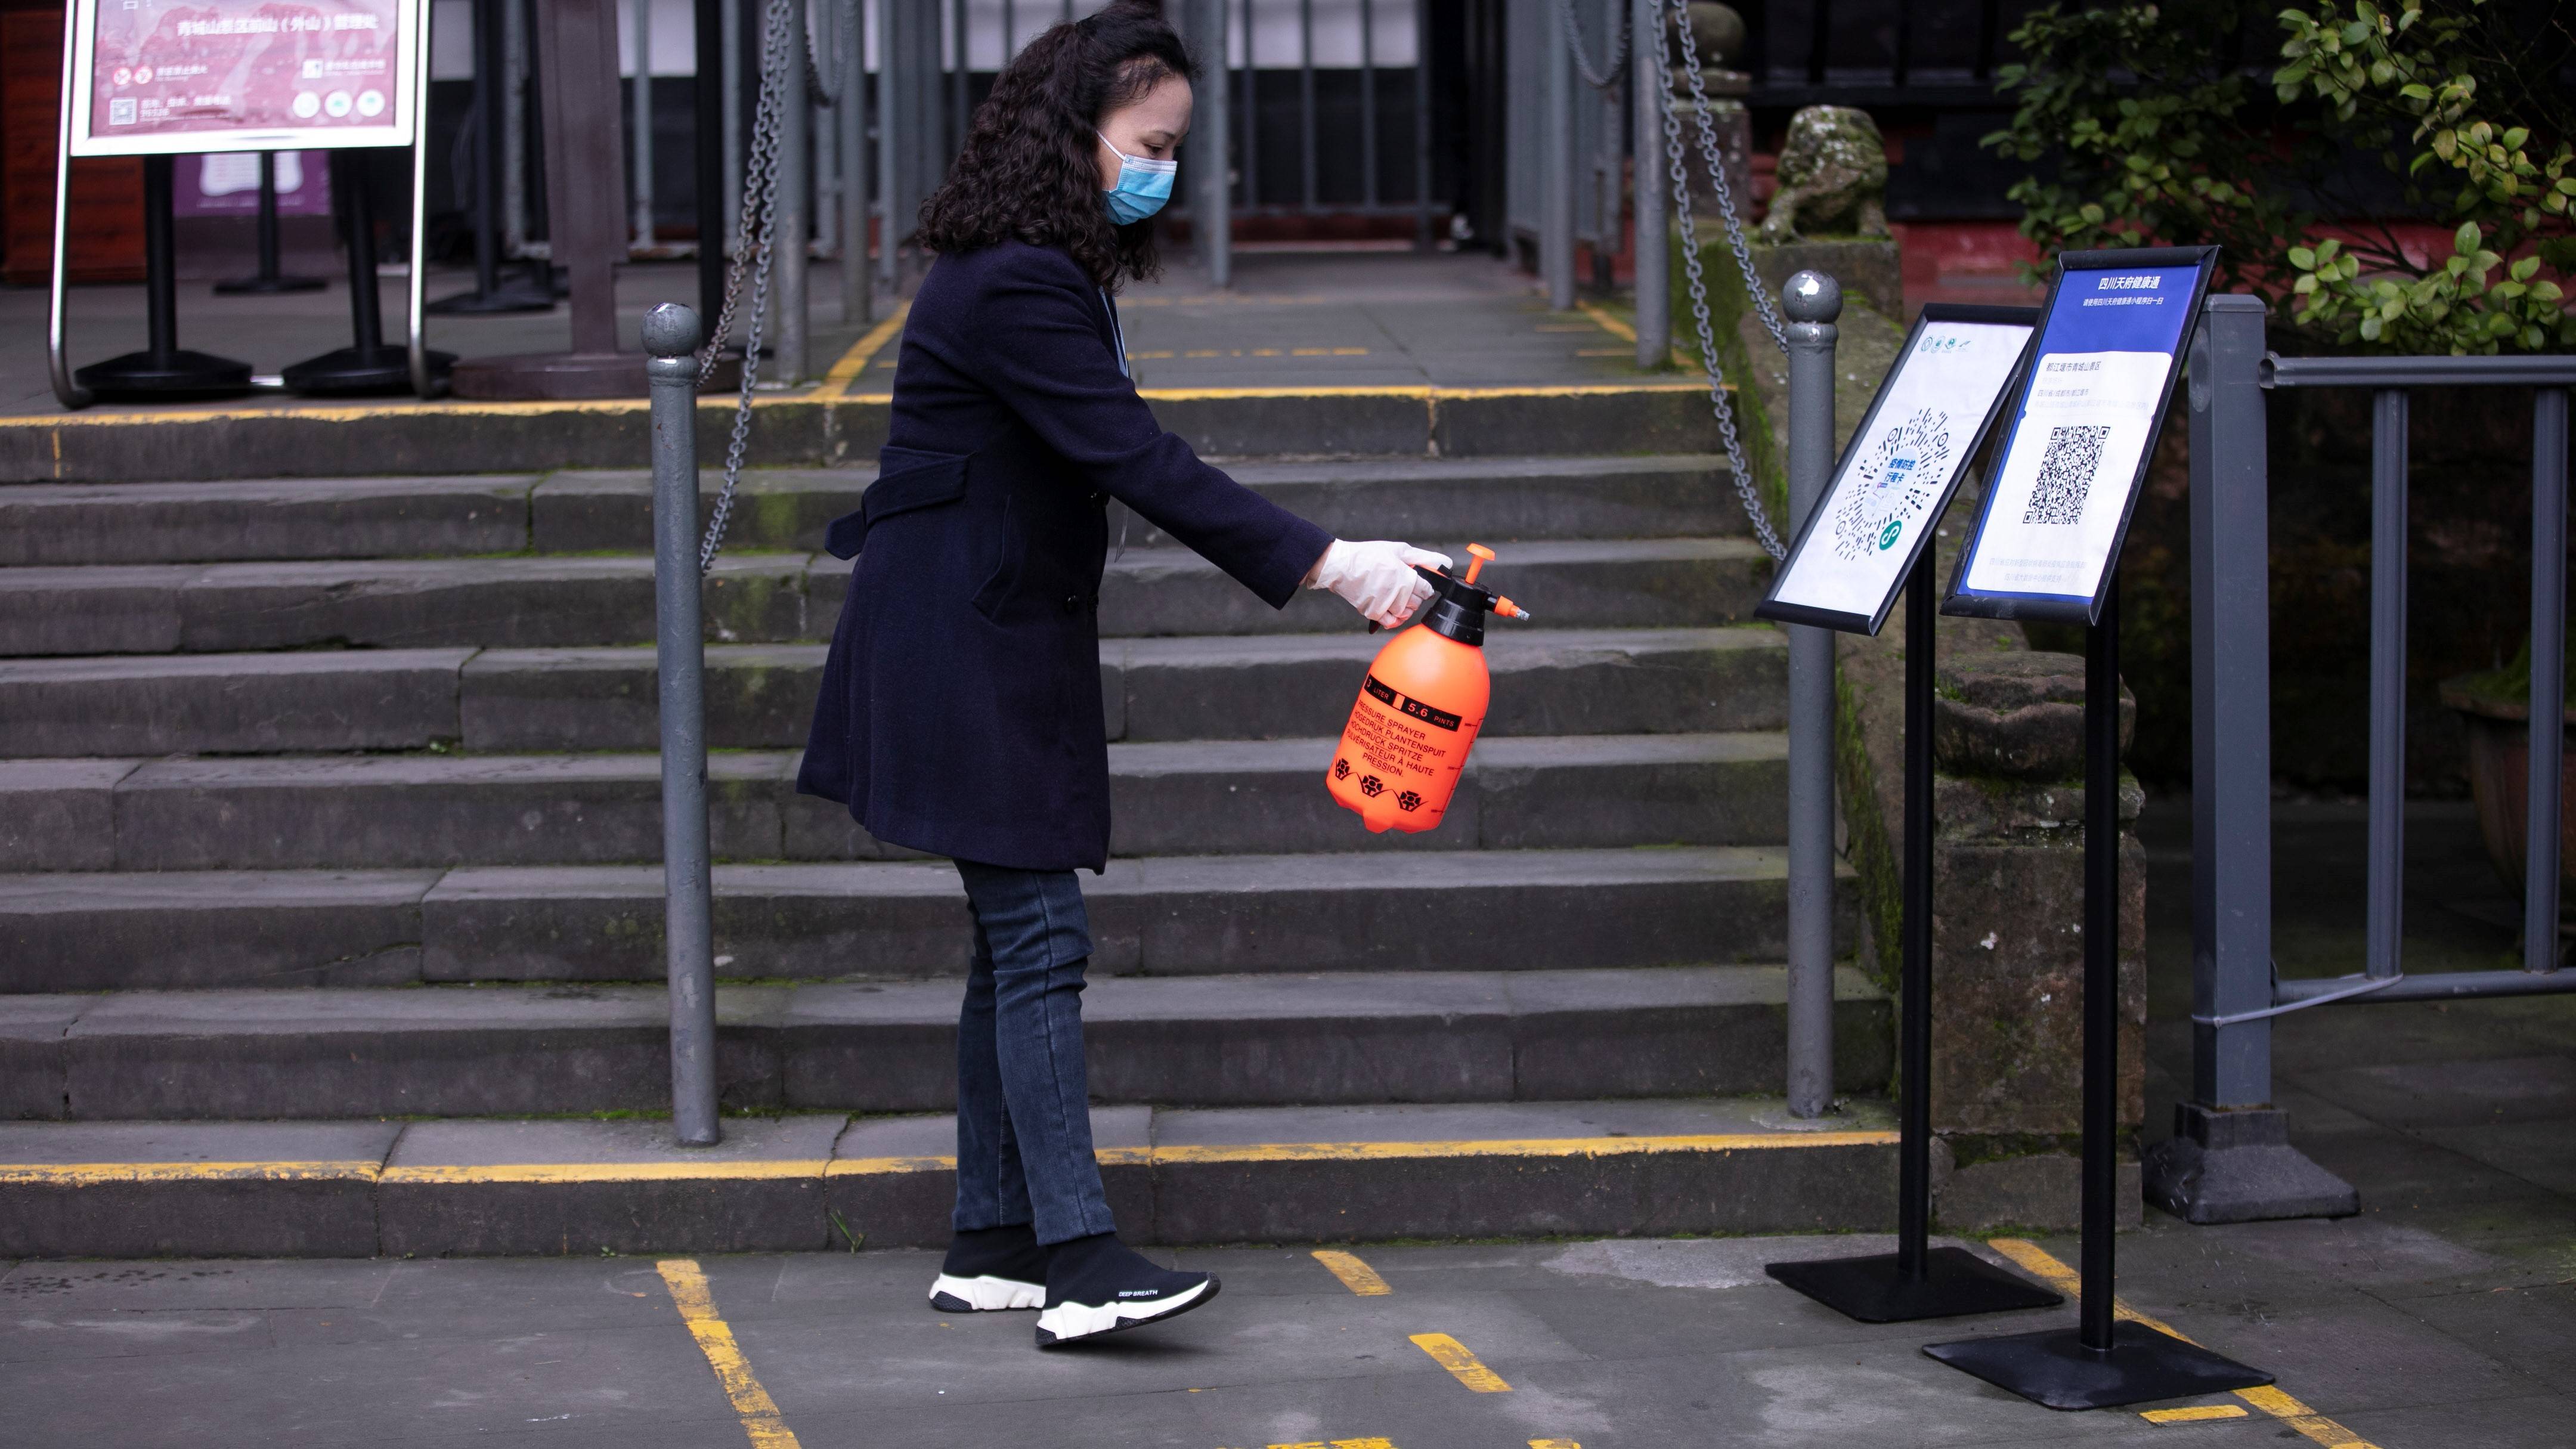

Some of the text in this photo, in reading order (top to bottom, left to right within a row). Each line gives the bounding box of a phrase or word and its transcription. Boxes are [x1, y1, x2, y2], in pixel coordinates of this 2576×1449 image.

[2098, 276, 2161, 290] 四川天府健康通
[2046, 361, 2101, 372] 都江堰市青城山景区
[1888, 458, 1916, 470] 疫情防控
[1884, 472, 1905, 484] 行程卡
[1367, 679, 1389, 700] 3 LITER
[1358, 699, 1426, 741] PRESSURE SPRAYER
[1408, 702, 1454, 727] 5.6 PINTS
[1351, 720, 1423, 761] HOCHDRUCK SPRITZE
[1355, 710, 1447, 758] HOGEDRUK PLANTENSPUIT
[1346, 728, 1396, 763] PULVÉRISATEUR
[1406, 761, 1435, 776] HAUTE
